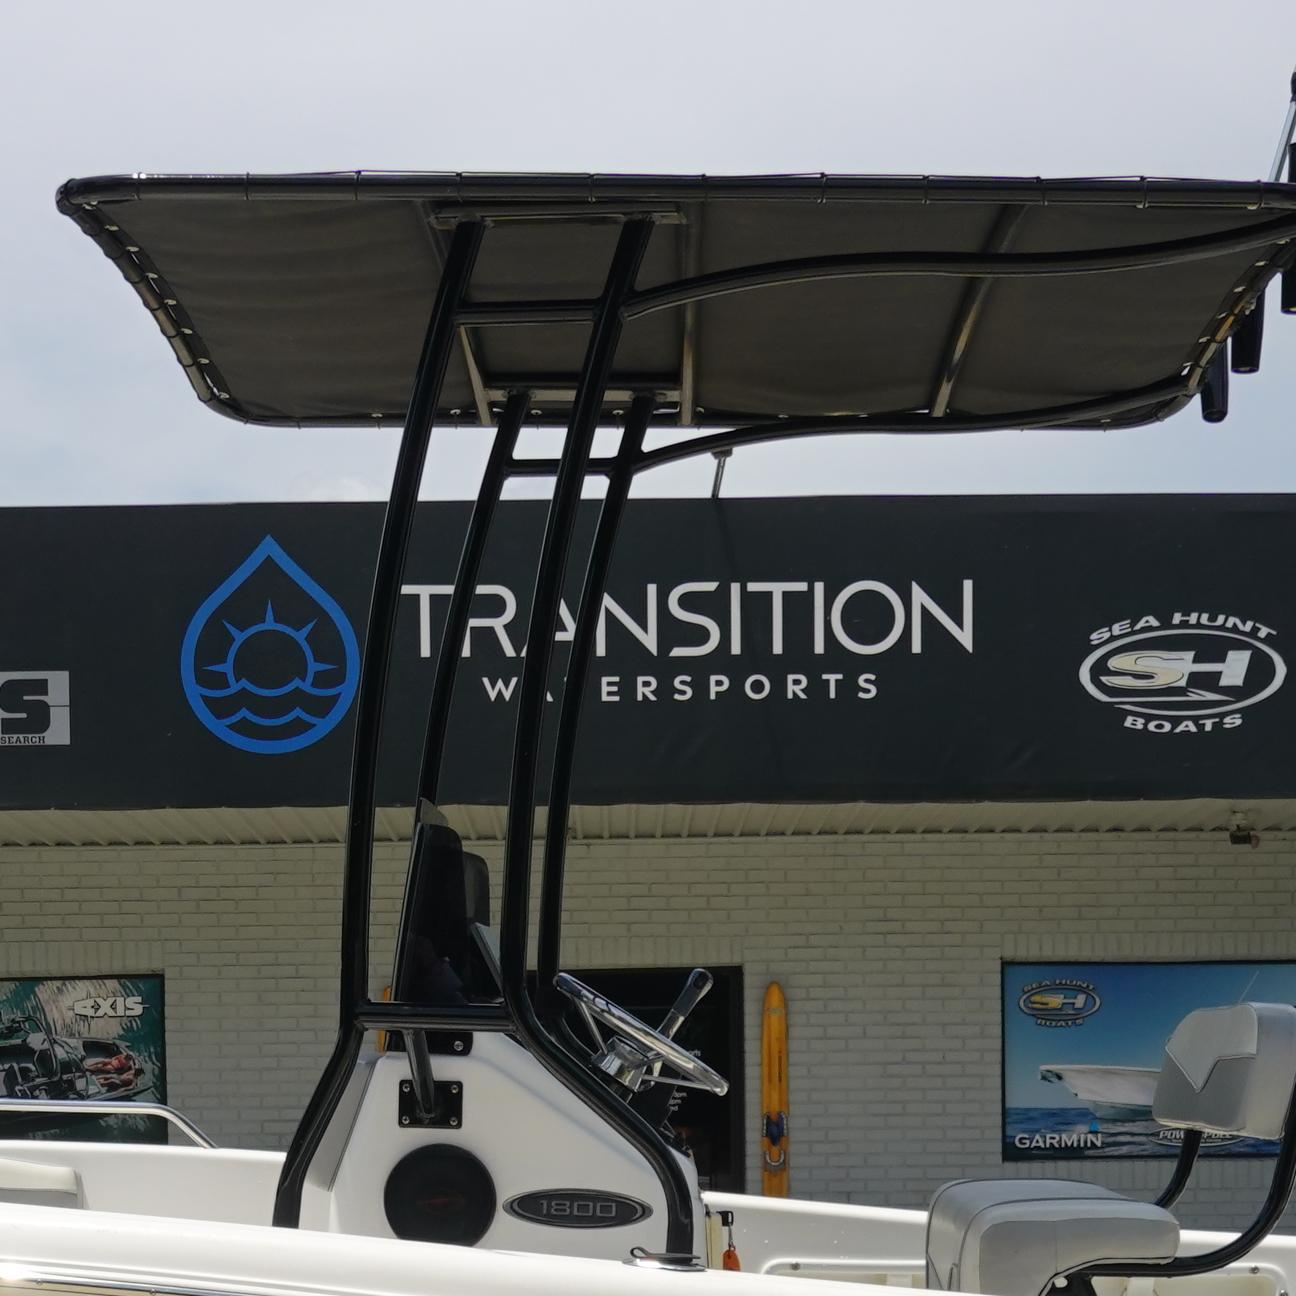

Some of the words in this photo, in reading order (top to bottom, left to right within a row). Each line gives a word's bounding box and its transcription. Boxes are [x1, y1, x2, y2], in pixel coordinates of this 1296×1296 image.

[1089, 615, 1161, 645] SEA
[1171, 612, 1277, 639] HUNT
[1099, 650, 1253, 690] SH
[481, 673, 878, 702] WERSPORTS
[1123, 713, 1243, 733] BOATS
[74, 996, 144, 1018] AXIS
[1015, 1132, 1102, 1149] GARMIN
[539, 1200, 616, 1217] 1800
